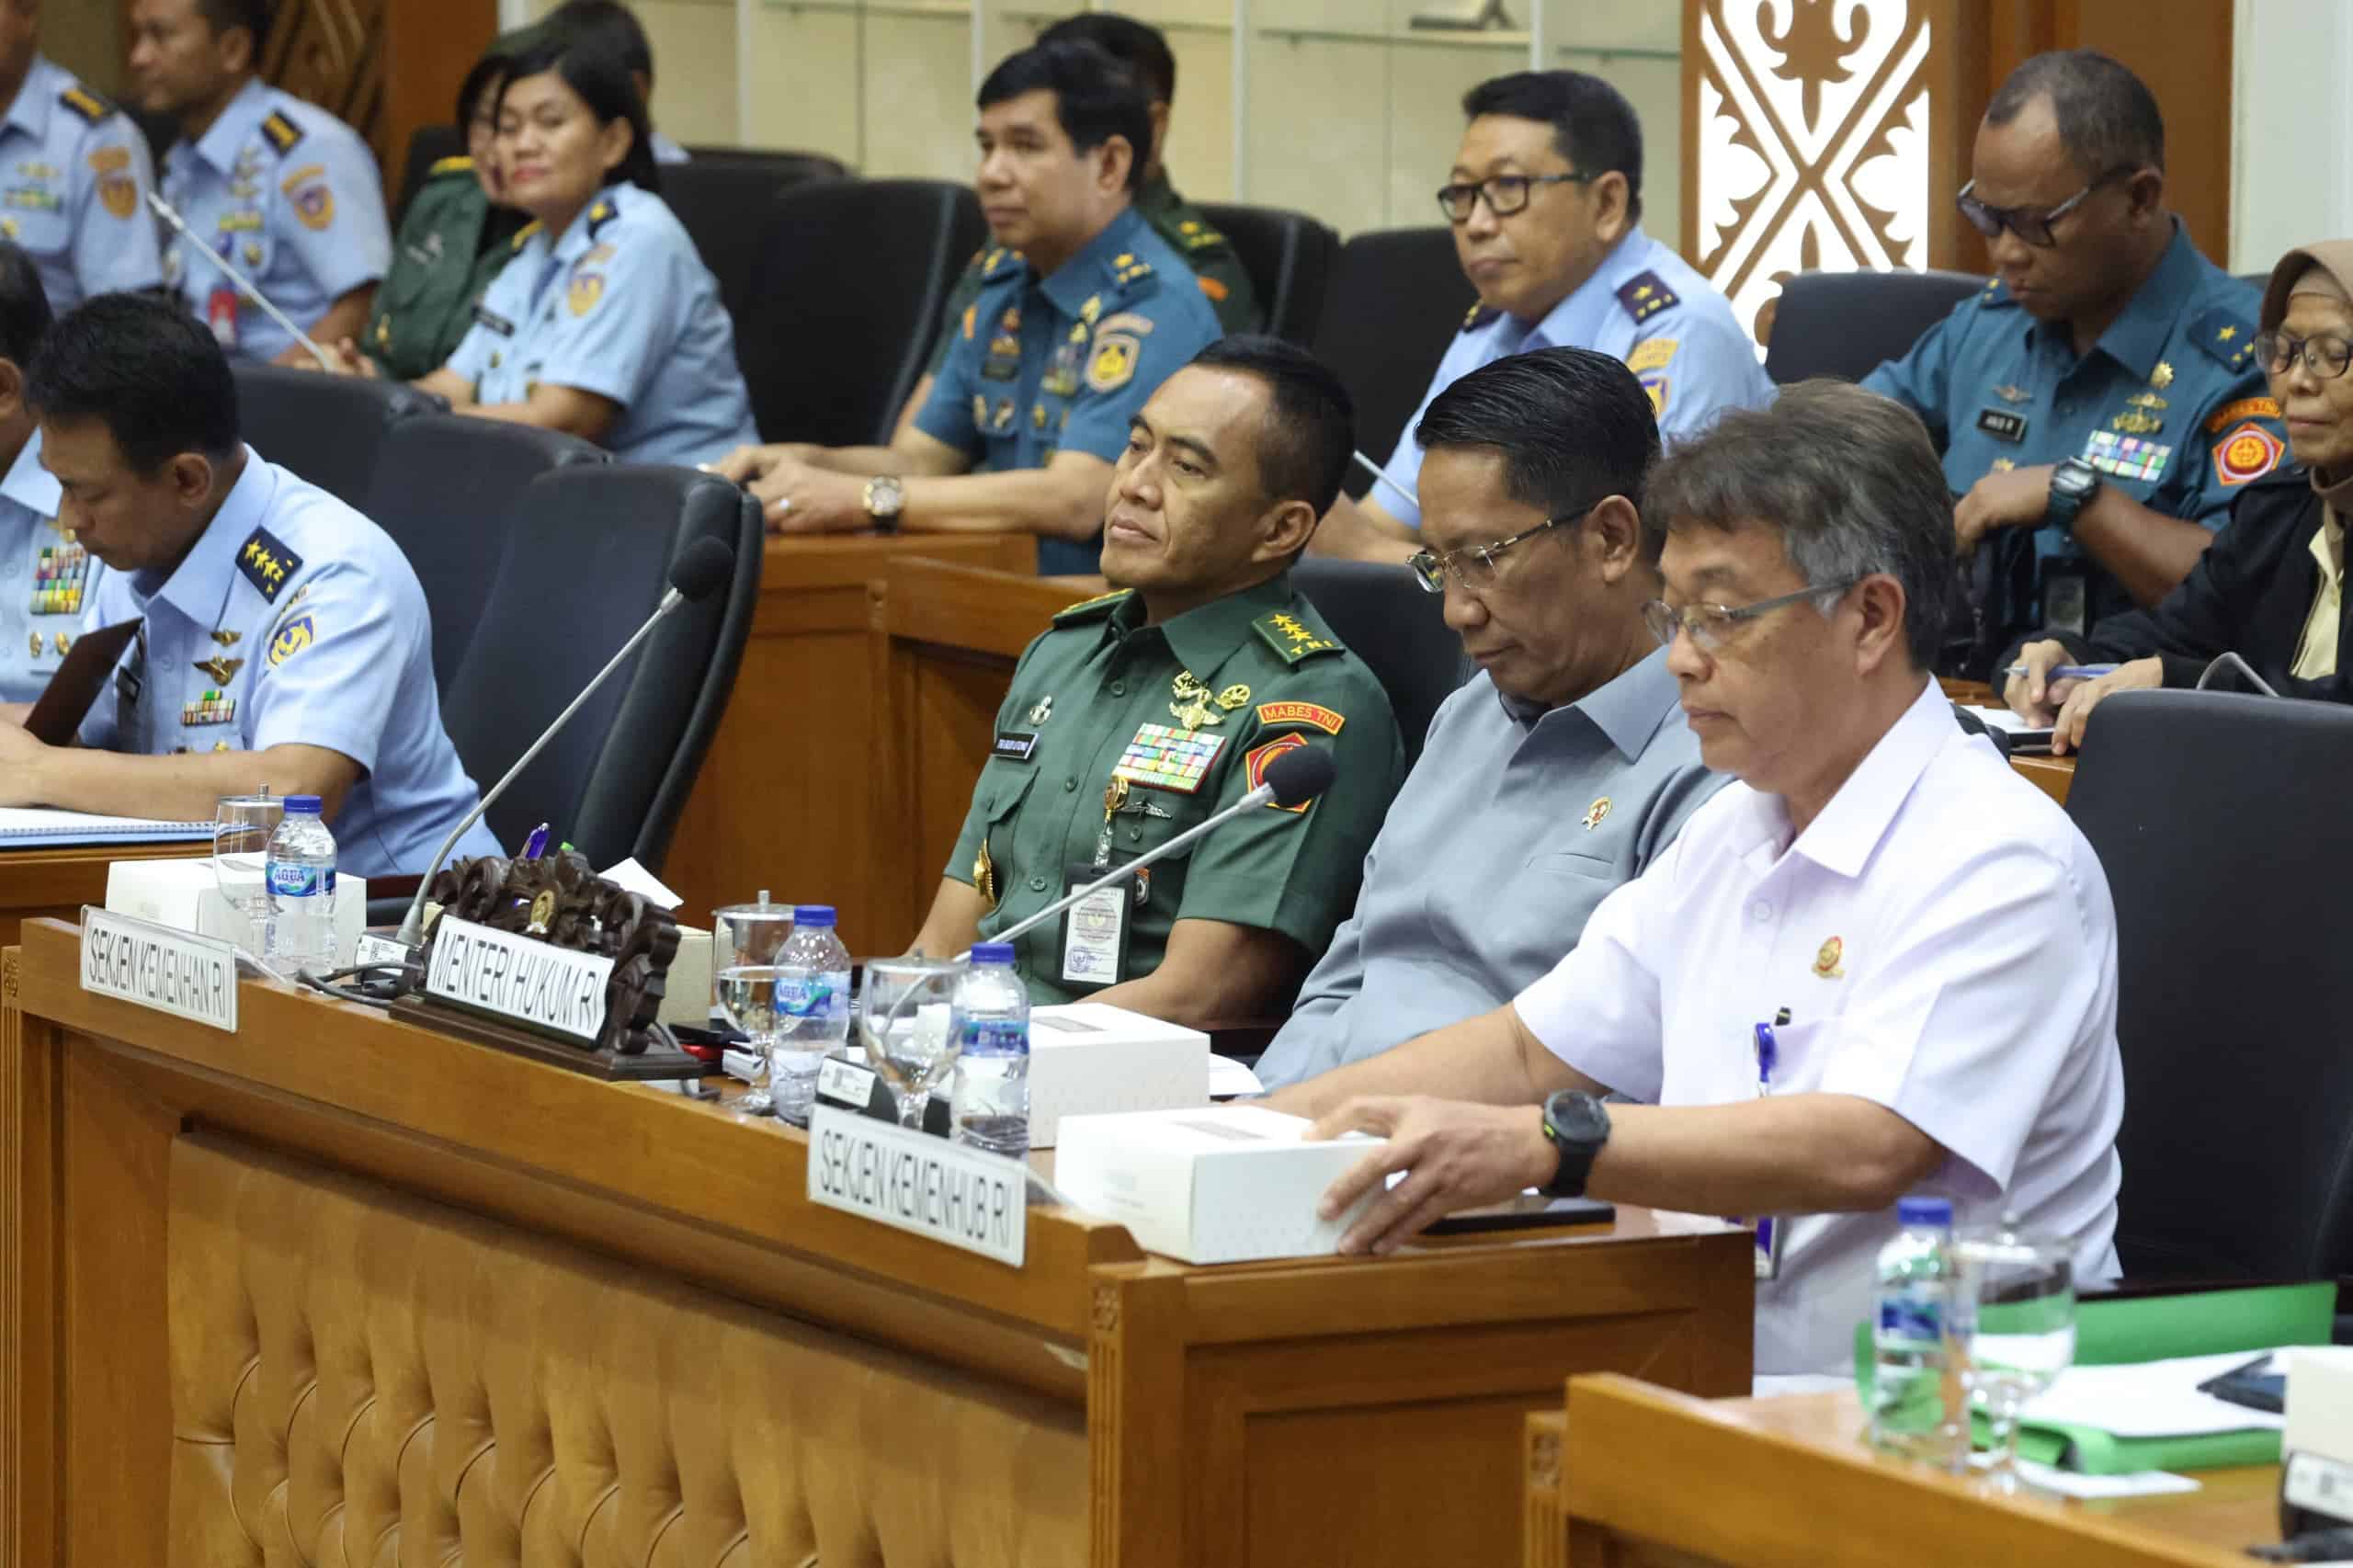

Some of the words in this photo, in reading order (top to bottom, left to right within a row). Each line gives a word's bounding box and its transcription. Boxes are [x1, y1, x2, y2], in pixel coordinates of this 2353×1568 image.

[1264, 706, 1313, 720] MABES
[1316, 710, 1337, 728] TNI
[274, 869, 305, 882] AQUA
[89, 927, 137, 993] SEKJEN
[140, 940, 210, 1015] KEMENHAN
[213, 961, 225, 1018] RI
[432, 930, 515, 1007] MENTERI
[511, 952, 581, 1026] HUKUM
[579, 971, 602, 1029] RI
[821, 1129, 886, 1209] SEKJEN
[890, 1148, 986, 1239] KEMENHUB
[993, 1181, 1009, 1248] RI
